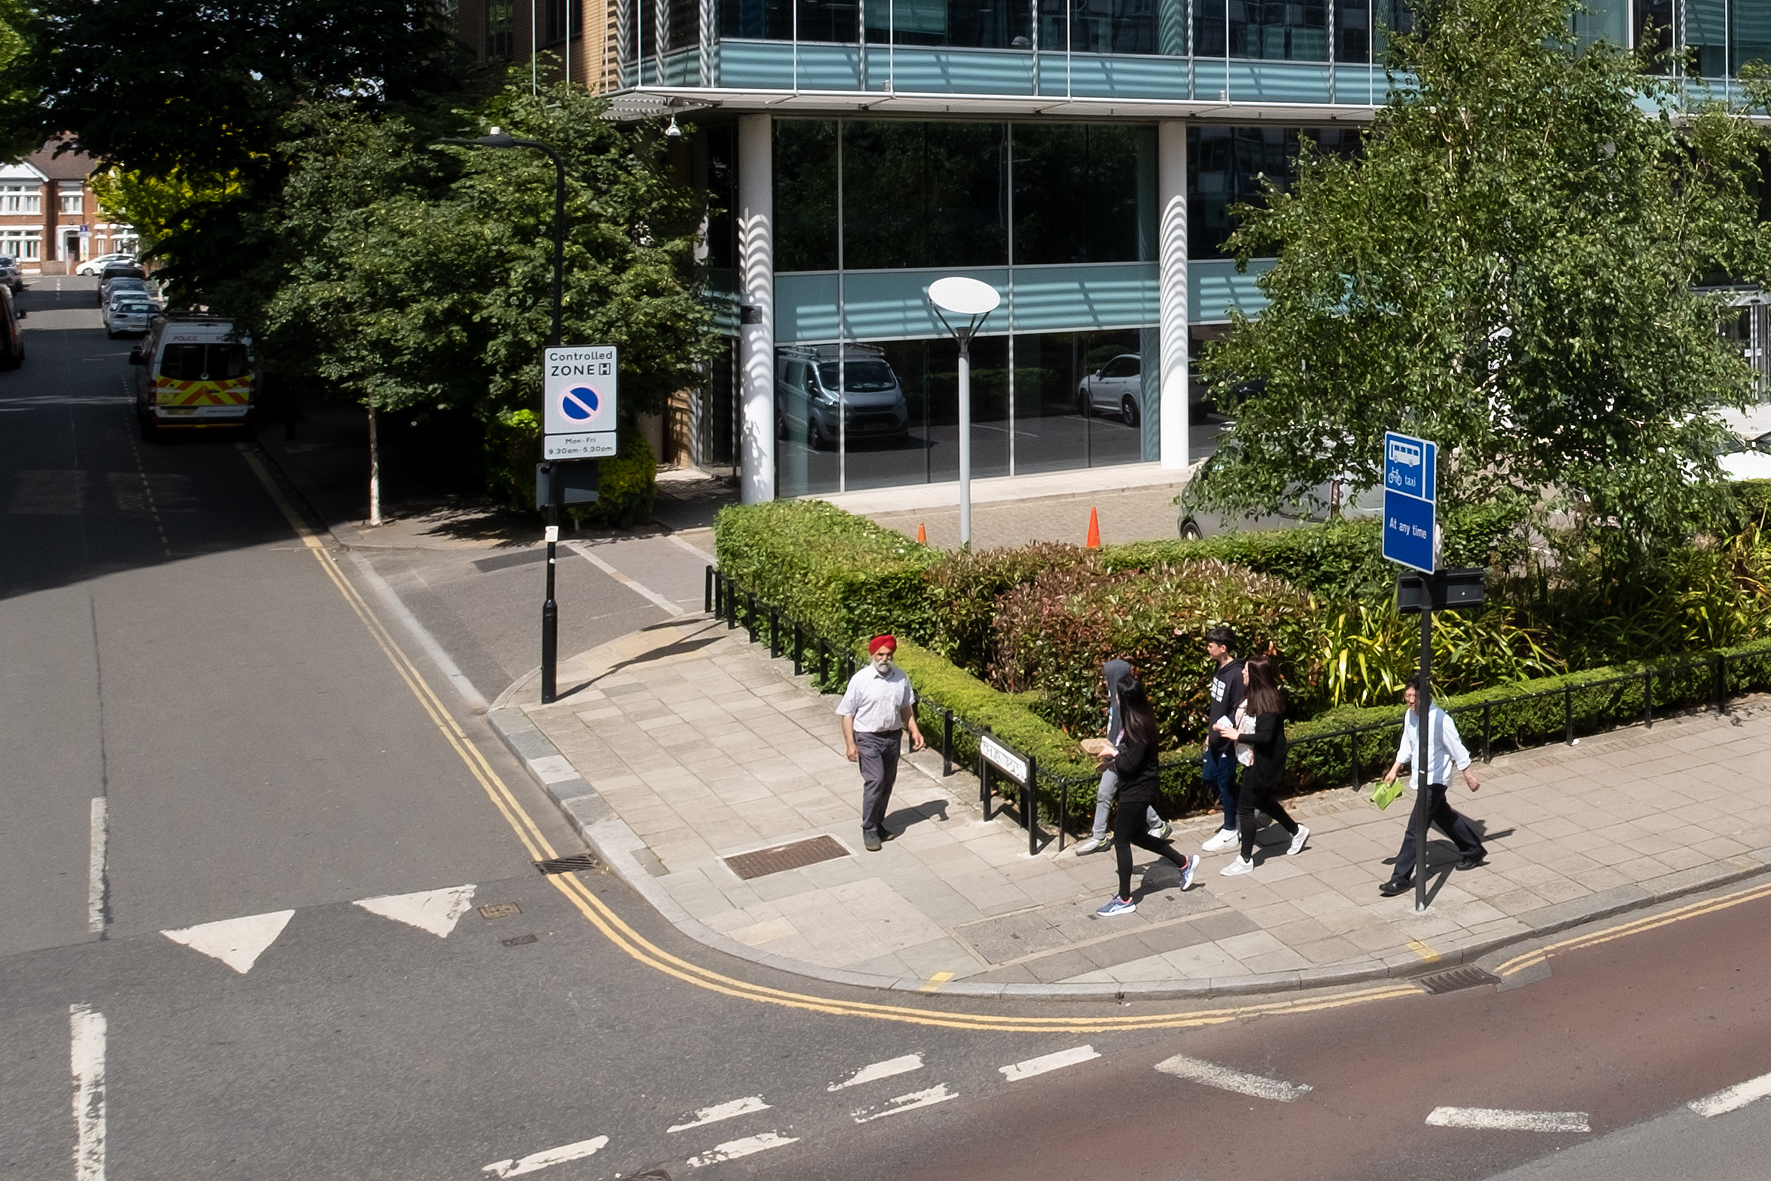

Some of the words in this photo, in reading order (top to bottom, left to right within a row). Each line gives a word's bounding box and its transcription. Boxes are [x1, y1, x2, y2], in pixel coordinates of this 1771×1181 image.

[549, 351, 613, 362] Controlled
[551, 364, 595, 376] ZONE
[599, 363, 611, 375] H
[1404, 475, 1416, 487] taxi
[1389, 517, 1398, 530] At
[1398, 522, 1411, 537] any
[1411, 524, 1427, 540] time
